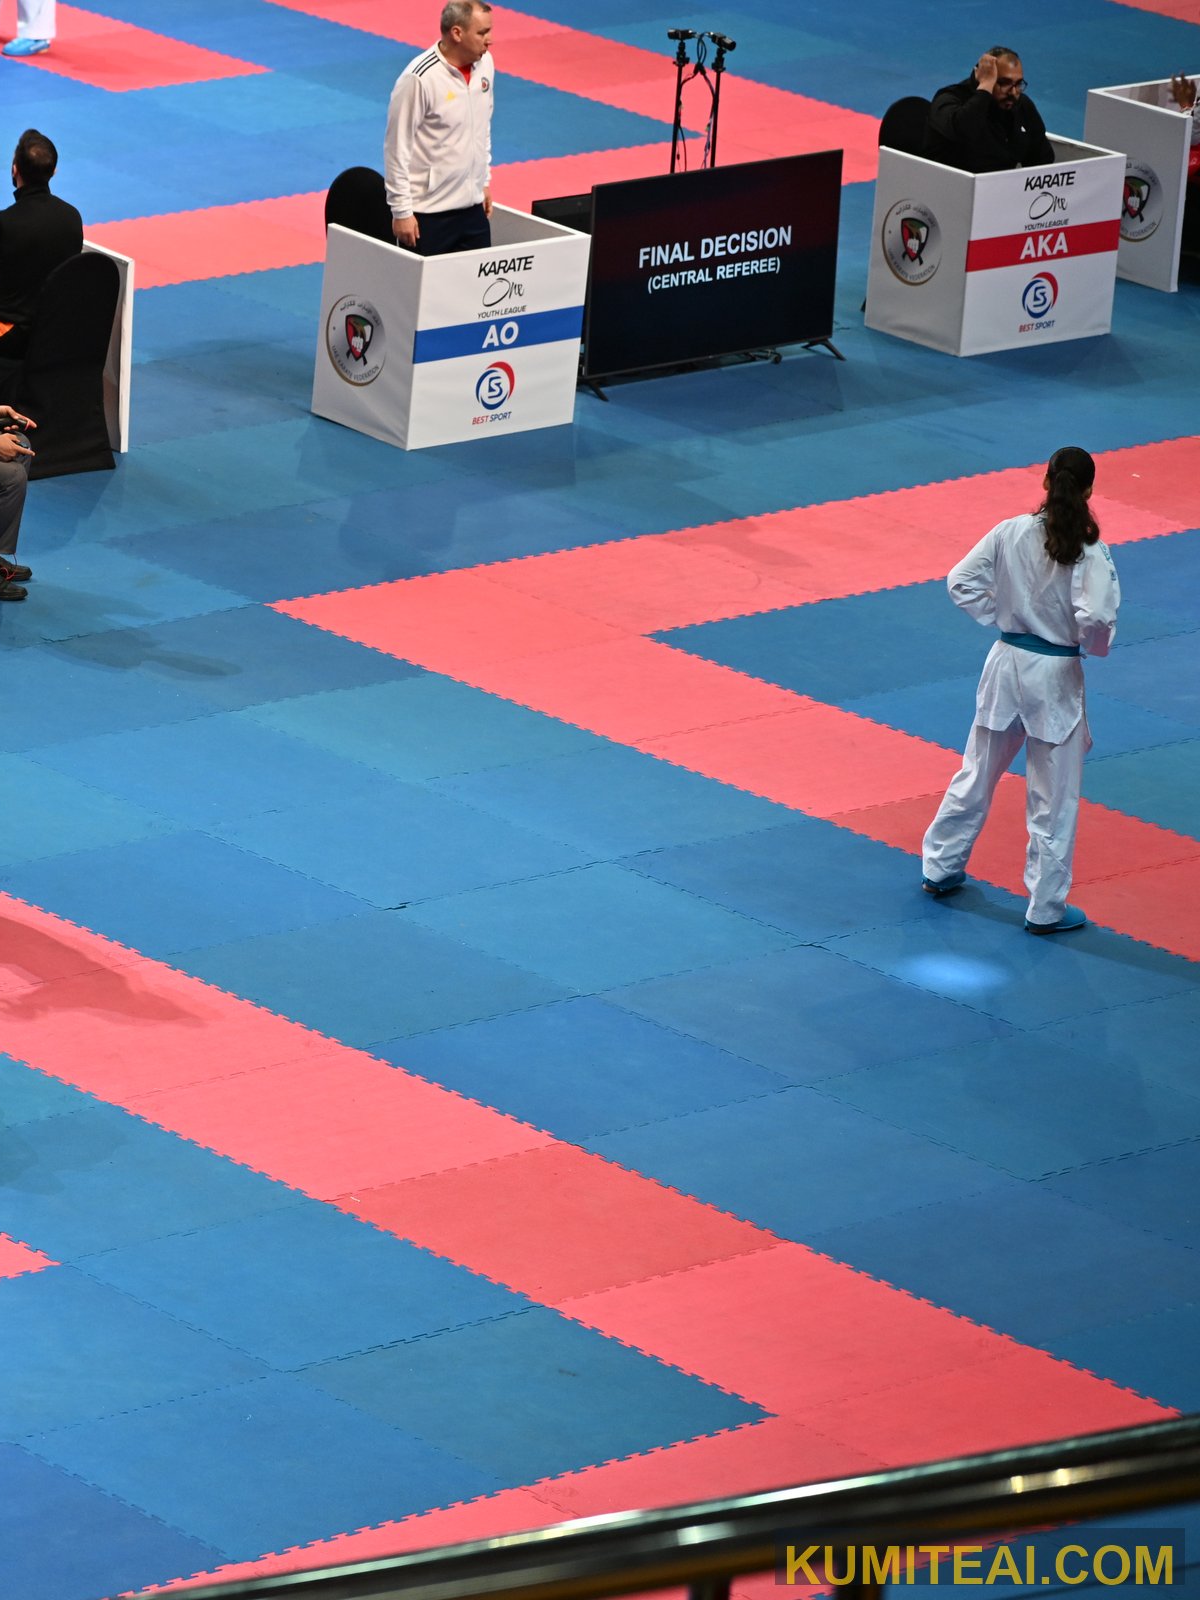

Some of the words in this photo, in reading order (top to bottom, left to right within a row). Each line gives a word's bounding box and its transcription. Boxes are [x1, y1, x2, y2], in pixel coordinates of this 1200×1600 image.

[1024, 171, 1076, 191] KARATE
[1029, 192, 1068, 220] One
[1024, 222, 1045, 231] YOUTH
[1045, 219, 1069, 228] LEAGUE
[638, 241, 695, 269] FINAL
[700, 225, 792, 259] DECISION
[1019, 232, 1068, 260] AKA
[478, 255, 534, 278] KARATE
[647, 268, 713, 294] (CENTRAL
[716, 256, 781, 281] REFEREE)
[482, 277, 525, 307] One
[478, 309, 500, 319] YOUTH
[500, 305, 526, 315] LEAGUE
[482, 321, 519, 348] AO
[1019, 323, 1035, 333] BEST
[1034, 320, 1055, 330] SPORT
[472, 415, 489, 425] BEST
[489, 411, 512, 422] SPORT
